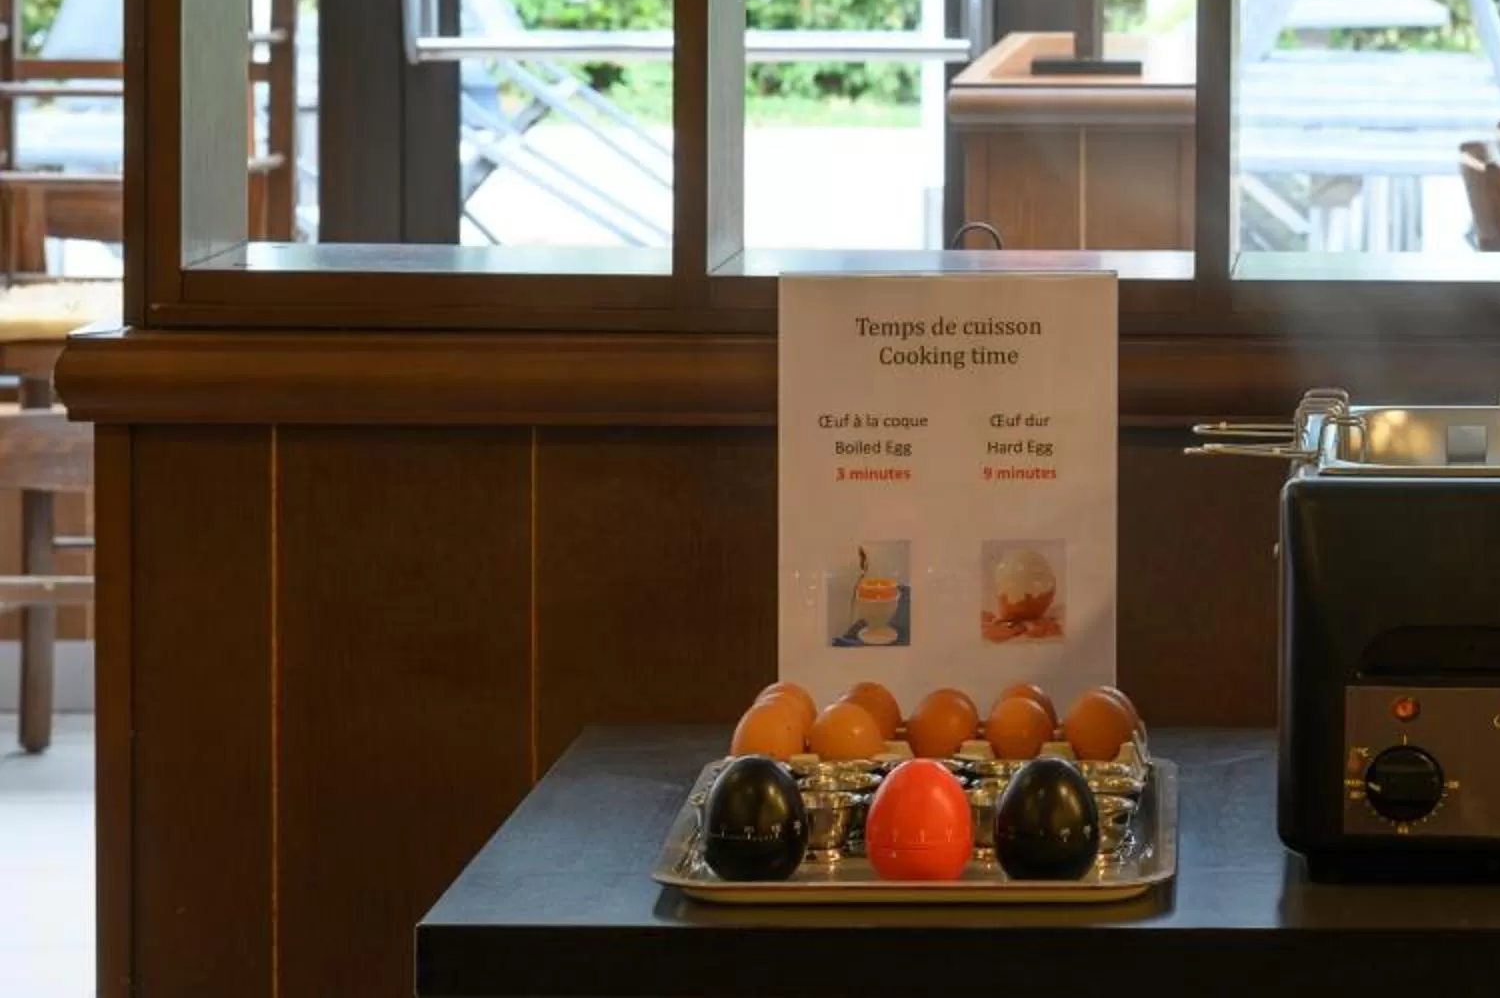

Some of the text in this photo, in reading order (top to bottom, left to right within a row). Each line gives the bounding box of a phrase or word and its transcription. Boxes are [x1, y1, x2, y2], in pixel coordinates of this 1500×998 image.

[855, 315, 1042, 340] Temps de cuisson
[879, 346, 1019, 370] Cooking time
[853, 413, 862, 428] à
[866, 414, 879, 427] la
[883, 416, 929, 430] coque
[1025, 413, 1051, 427] dur
[835, 440, 912, 456] Boiled Egg
[987, 440, 1053, 456] Hard Egg
[836, 467, 912, 482] 3 minutes
[983, 465, 1057, 481] 9 minutes
